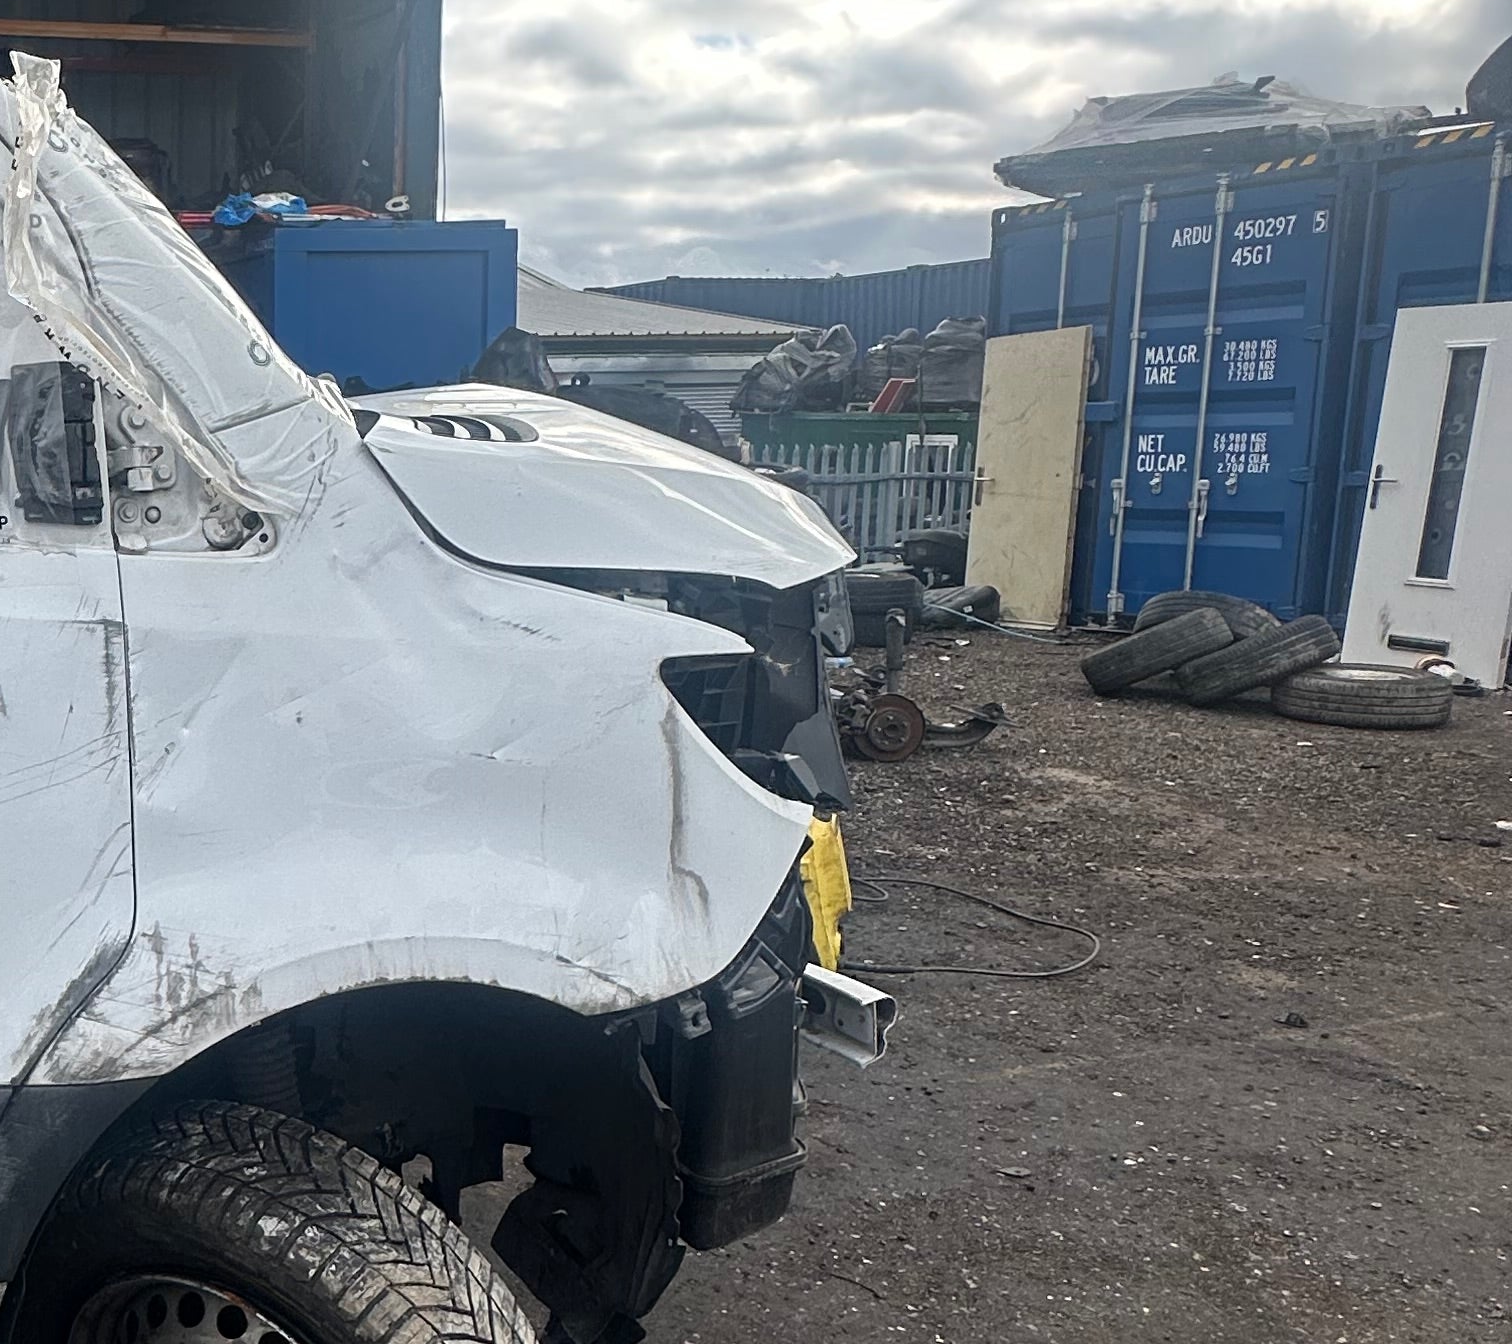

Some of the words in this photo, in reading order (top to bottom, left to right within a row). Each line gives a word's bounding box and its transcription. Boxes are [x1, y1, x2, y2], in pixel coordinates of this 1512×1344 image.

[1171, 224, 1213, 249] ARDU
[1234, 214, 1297, 241] 450297
[1314, 210, 1327, 232] 5
[1231, 244, 1272, 266] 45G1
[1145, 345, 1200, 365] MAX.GR.
[1145, 366, 1178, 385] TARE
[1138, 434, 1165, 453] NET
[1251, 433, 1267, 443] KGS
[1137, 454, 1187, 473] CU.CAP.
[1217, 463, 1244, 473] 2.700
